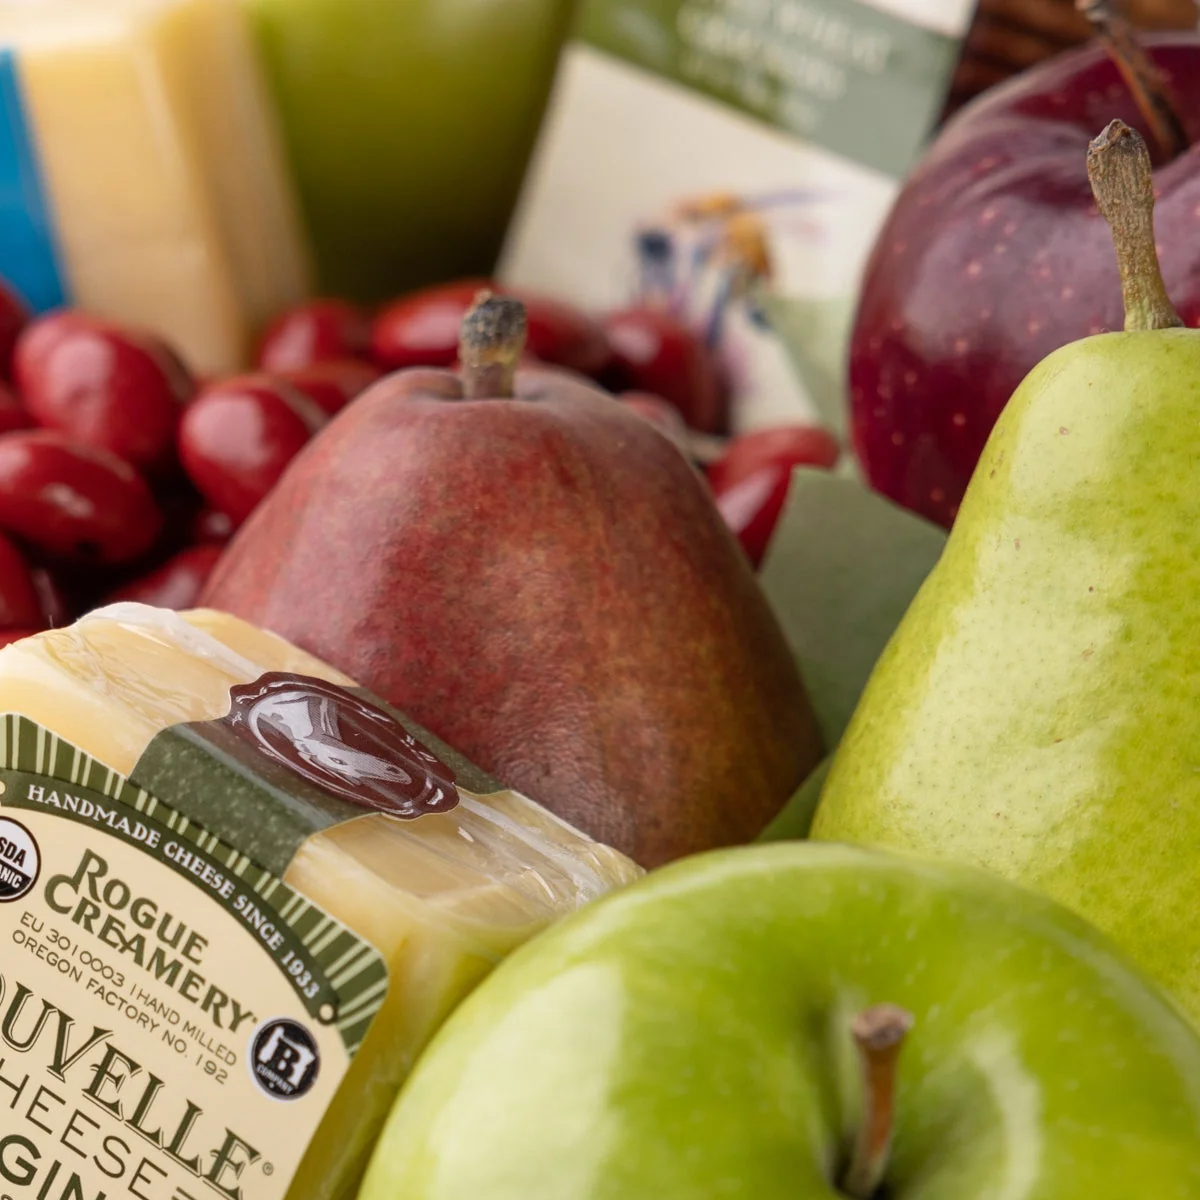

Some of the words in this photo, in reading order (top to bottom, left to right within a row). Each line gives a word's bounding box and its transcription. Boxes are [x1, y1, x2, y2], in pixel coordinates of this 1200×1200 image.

[27, 784, 162, 848] HANDMADE
[163, 840, 237, 899] CHEESE
[233, 894, 285, 950] SINCE
[281, 950, 320, 998] 1933
[44, 873, 254, 1034] CREAMERY
[71, 847, 209, 966] ROGUE
[11, 929, 84, 984] OREGON
[86, 978, 160, 1034] FACTORY
[161, 1029, 189, 1059] NO.
[195, 1054, 229, 1085] 192
[20, 911, 45, 933] EU
[182, 1020, 237, 1067] MILLED
